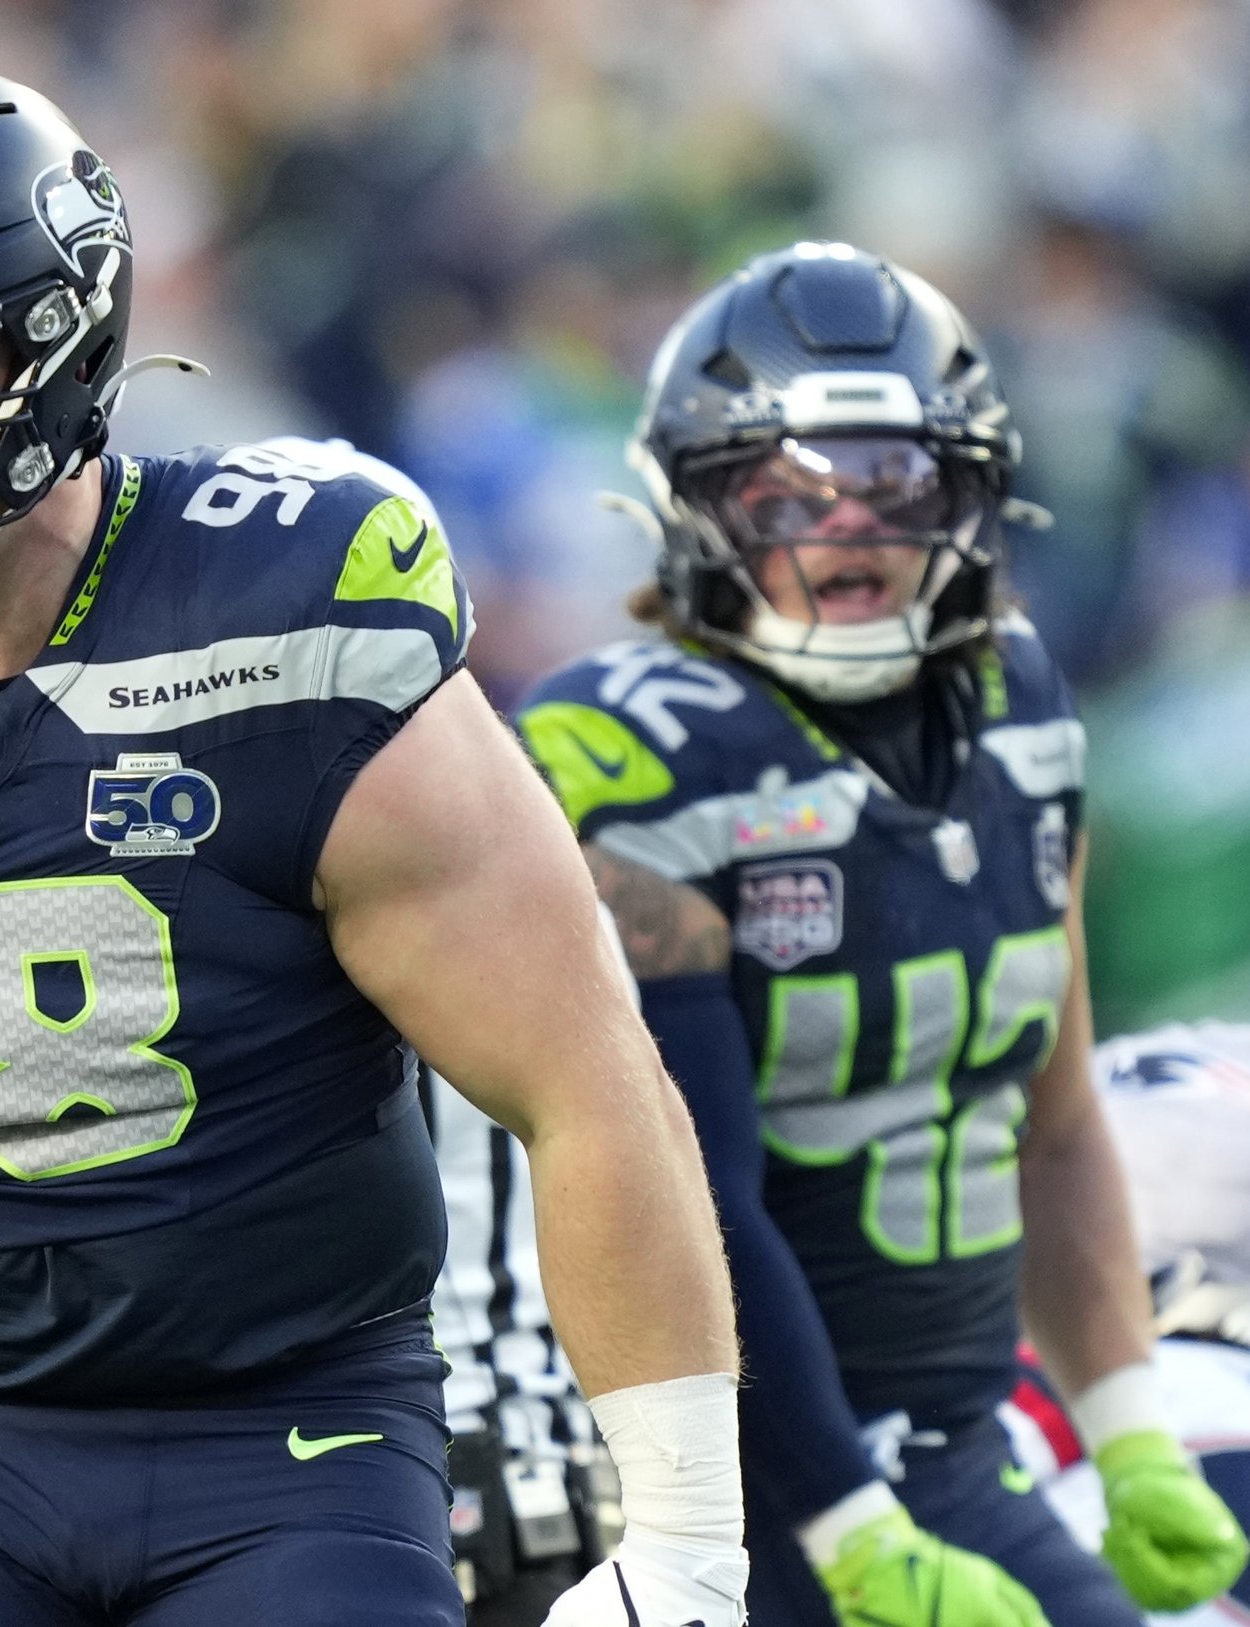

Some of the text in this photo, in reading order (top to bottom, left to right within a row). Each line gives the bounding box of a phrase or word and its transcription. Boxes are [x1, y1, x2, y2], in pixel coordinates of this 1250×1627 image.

[108, 664, 280, 709] SEAHAWKS
[90, 773, 216, 842] 50
[755, 924, 1072, 1265] 42
